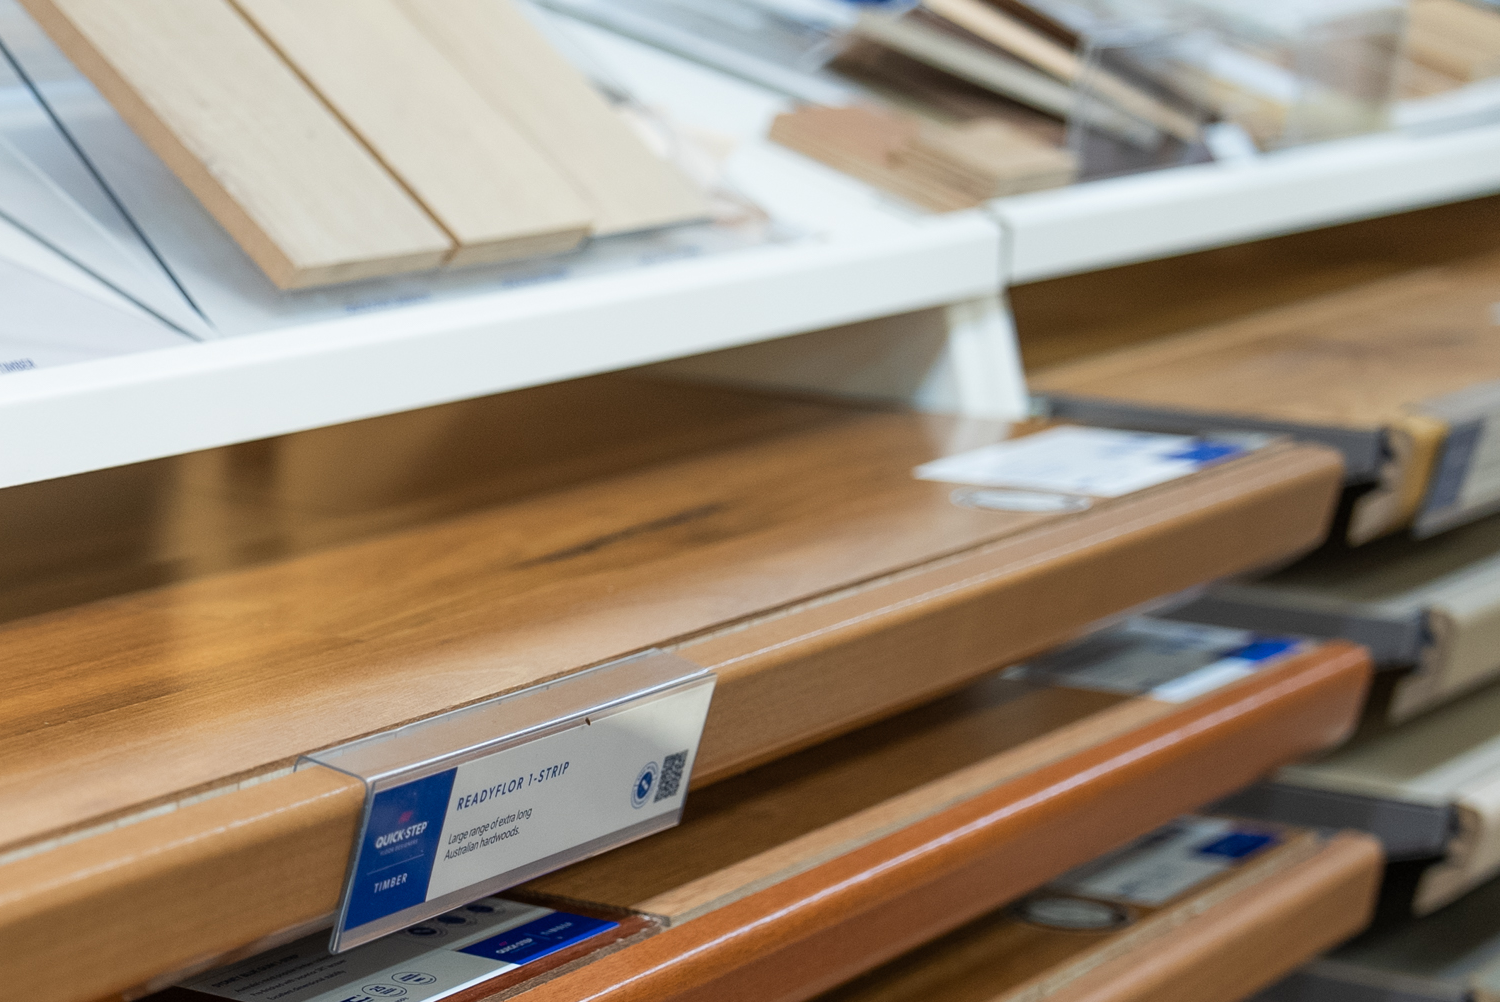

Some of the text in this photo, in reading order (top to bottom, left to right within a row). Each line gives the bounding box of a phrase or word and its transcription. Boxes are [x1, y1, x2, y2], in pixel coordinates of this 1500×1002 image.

[456, 761, 570, 811] READYFLOR 1-STRIP
[448, 807, 533, 845] Large range of extra long
[443, 840, 479, 861] Australian
[373, 873, 408, 894] TIMBER
